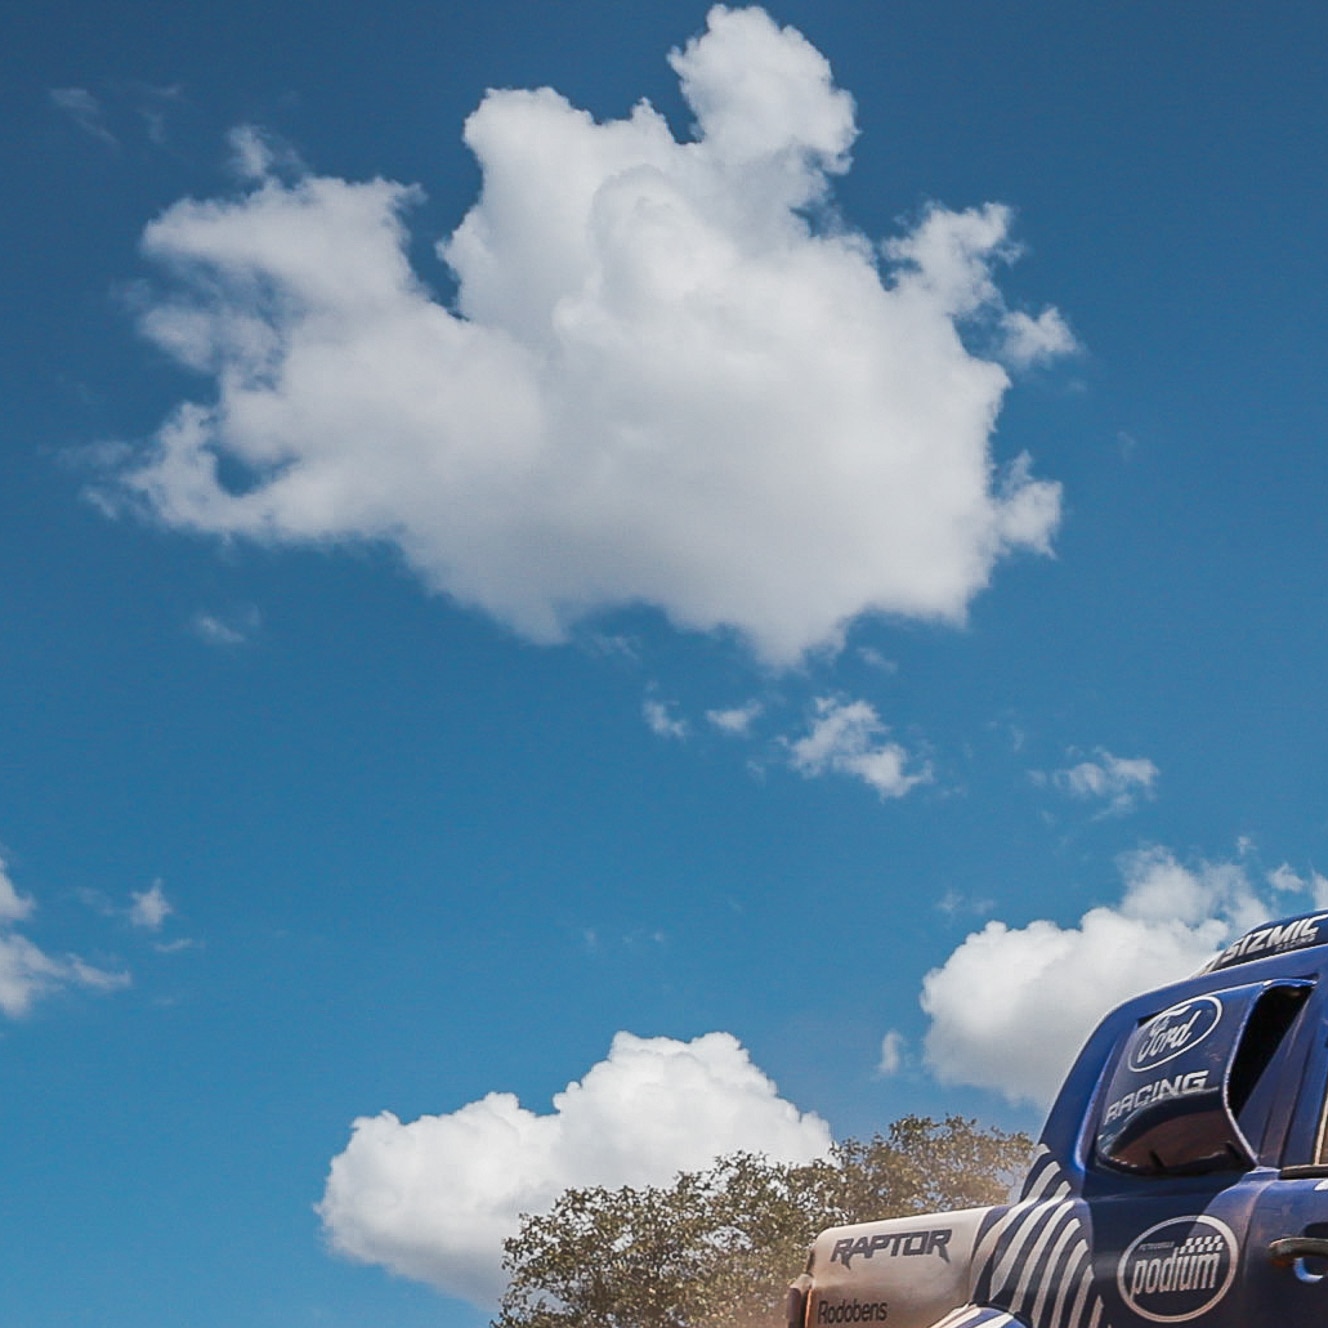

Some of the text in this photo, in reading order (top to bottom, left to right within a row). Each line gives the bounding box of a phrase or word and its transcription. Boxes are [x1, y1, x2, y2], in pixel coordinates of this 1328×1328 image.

[1103, 1069, 1210, 1126] RACING
[830, 1229, 952, 1270] RAPTOR
[1130, 1246, 1221, 1301] podium
[817, 1298, 888, 1325] Rodobens
